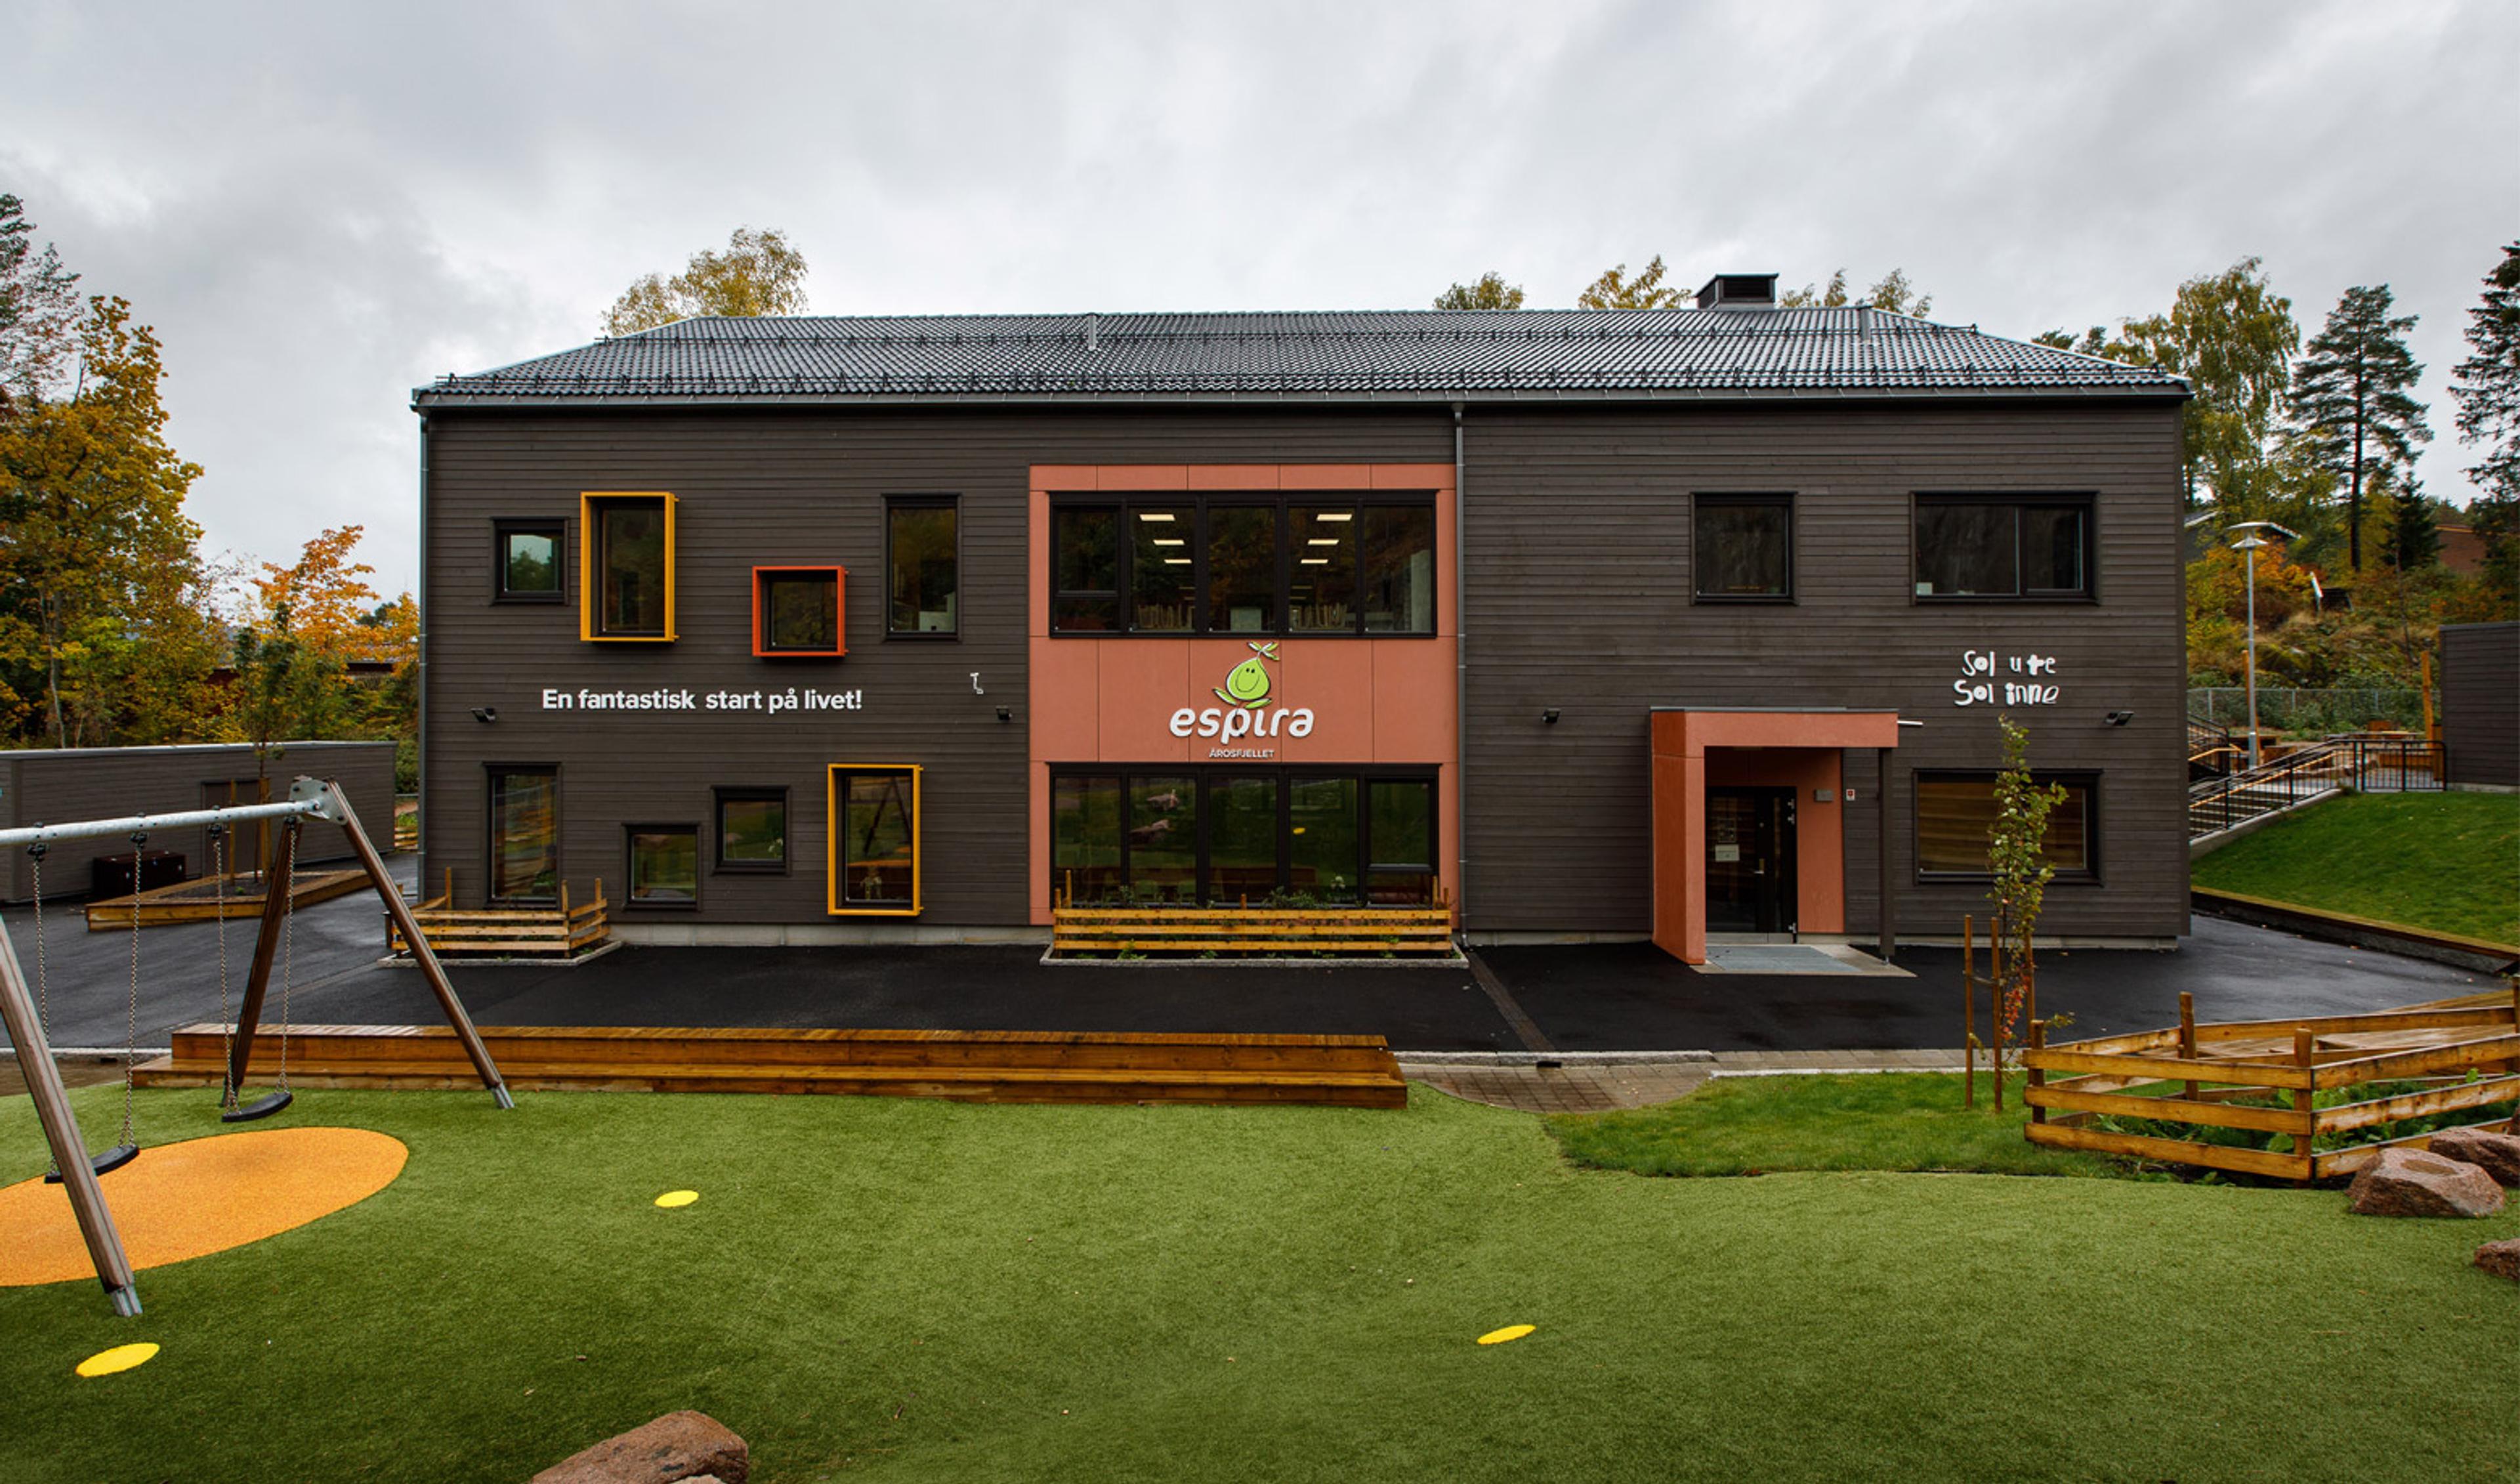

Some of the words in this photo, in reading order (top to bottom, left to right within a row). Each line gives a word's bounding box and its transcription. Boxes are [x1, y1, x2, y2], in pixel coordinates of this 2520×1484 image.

[1962, 650, 1995, 677] Sol
[2009, 654, 2056, 676] ute
[543, 689, 573, 709] En
[578, 689, 696, 710] fantastisk
[705, 691, 763, 710] start
[768, 688, 798, 713] på
[805, 689, 862, 710] livet!
[1954, 679, 1994, 706] Sol
[2005, 682, 2059, 706] inne
[1169, 708, 1314, 744] espira
[1209, 748, 1274, 758] ÅROSFJELLET
